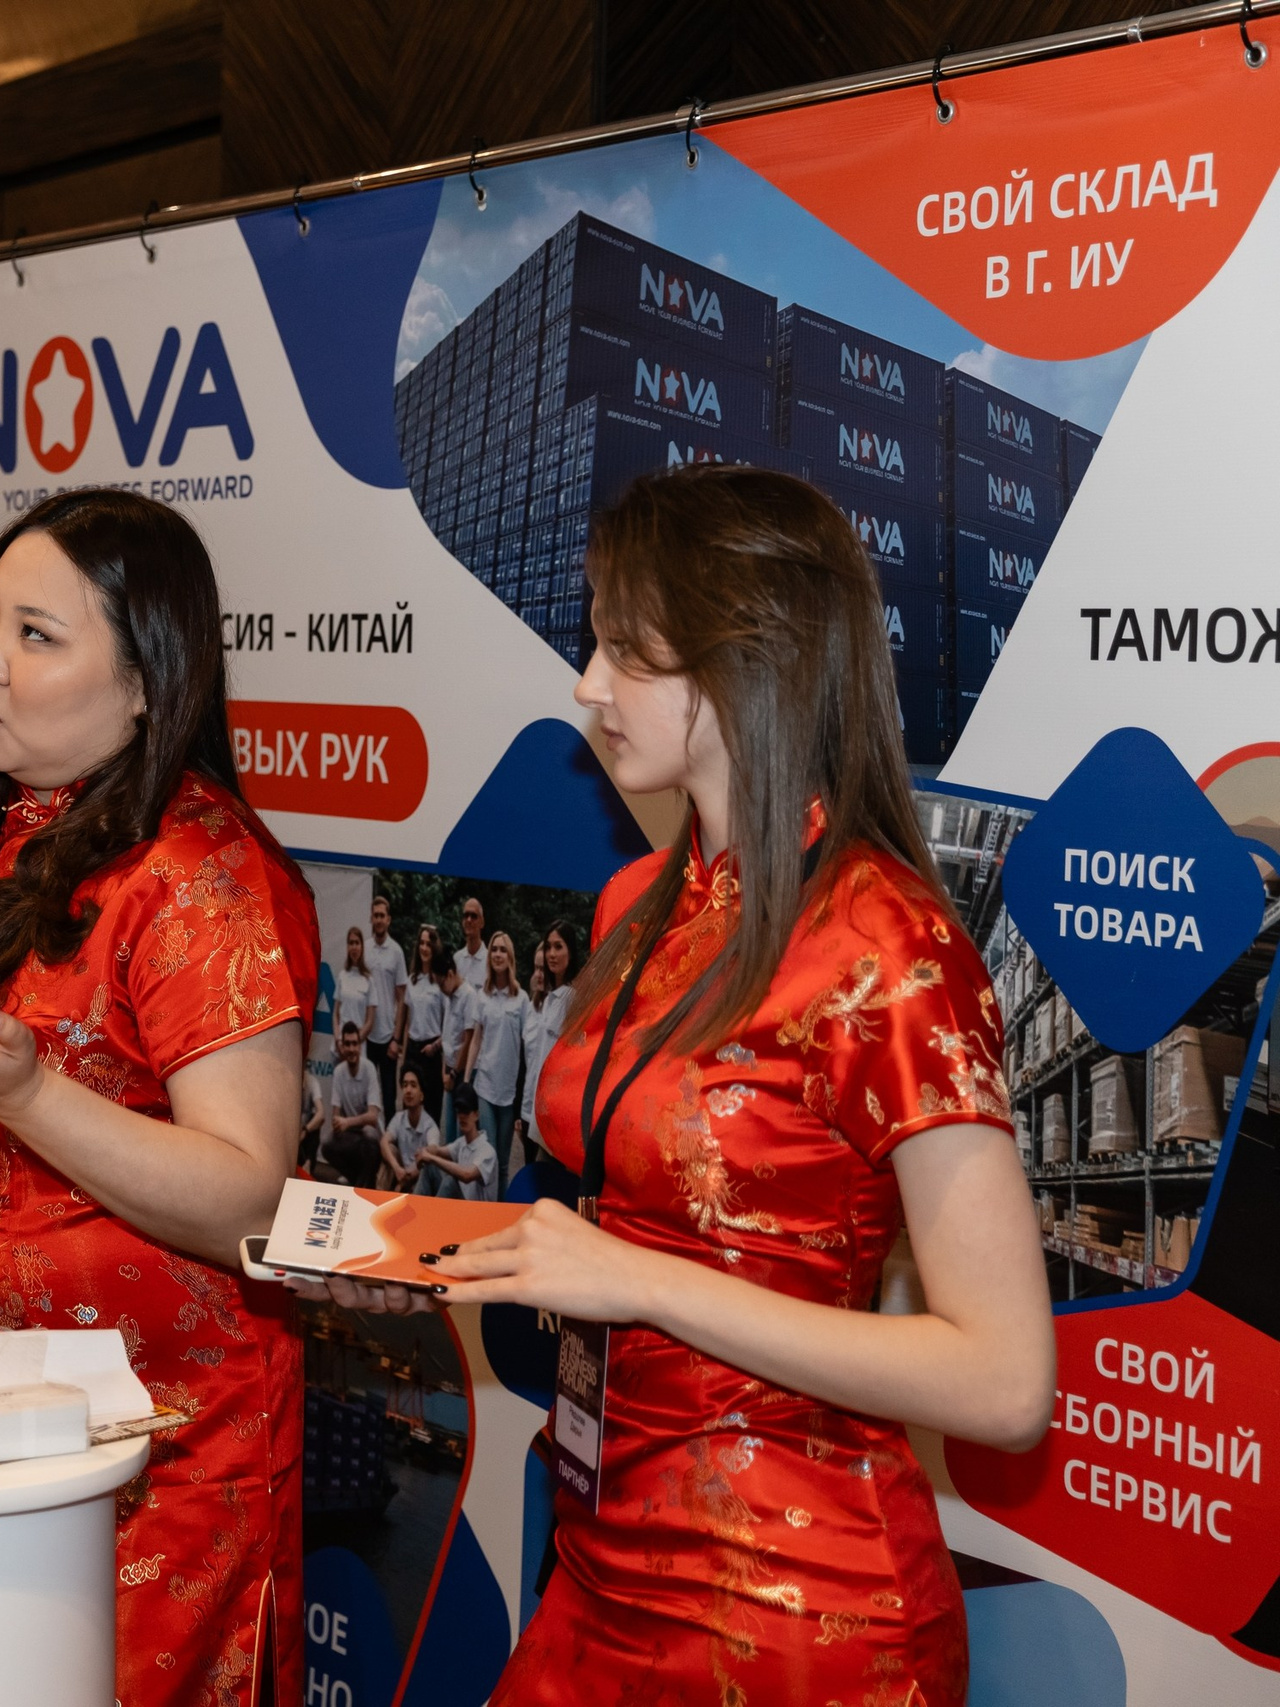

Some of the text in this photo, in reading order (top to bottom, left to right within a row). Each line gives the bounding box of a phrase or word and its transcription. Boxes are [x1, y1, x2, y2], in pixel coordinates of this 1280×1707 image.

[916, 152, 1218, 237] СВОЙ СКЛАД
[985, 238, 1135, 299] В Г. ИУ
[640, 263, 725, 331] NOVA
[635, 358, 722, 422] NOVA
[840, 342, 906, 397] NOVA
[839, 423, 905, 475] NOVA
[987, 401, 1033, 447] NOVA
[150, 474, 254, 502] FORWARD
[988, 473, 1035, 517] NOVA
[988, 547, 1036, 587] NOVA
[307, 601, 413, 654] КИТАЙ
[1080, 606, 1280, 664] ТАМОЖ
[320, 732, 389, 784] РУК
[1063, 847, 1196, 893] ПОИСК
[1053, 902, 1204, 953] ТОВАРА
[304, 1217, 334, 1248] NOVA
[560, 1344, 597, 1387] BUSINESS
[561, 1327, 585, 1359] CHINA
[558, 1361, 587, 1398] FORUM
[1095, 1337, 1215, 1404] СВОЙ
[558, 1459, 590, 1495] ПАРТНЁР
[1063, 1458, 1232, 1544] СЕРВИС
